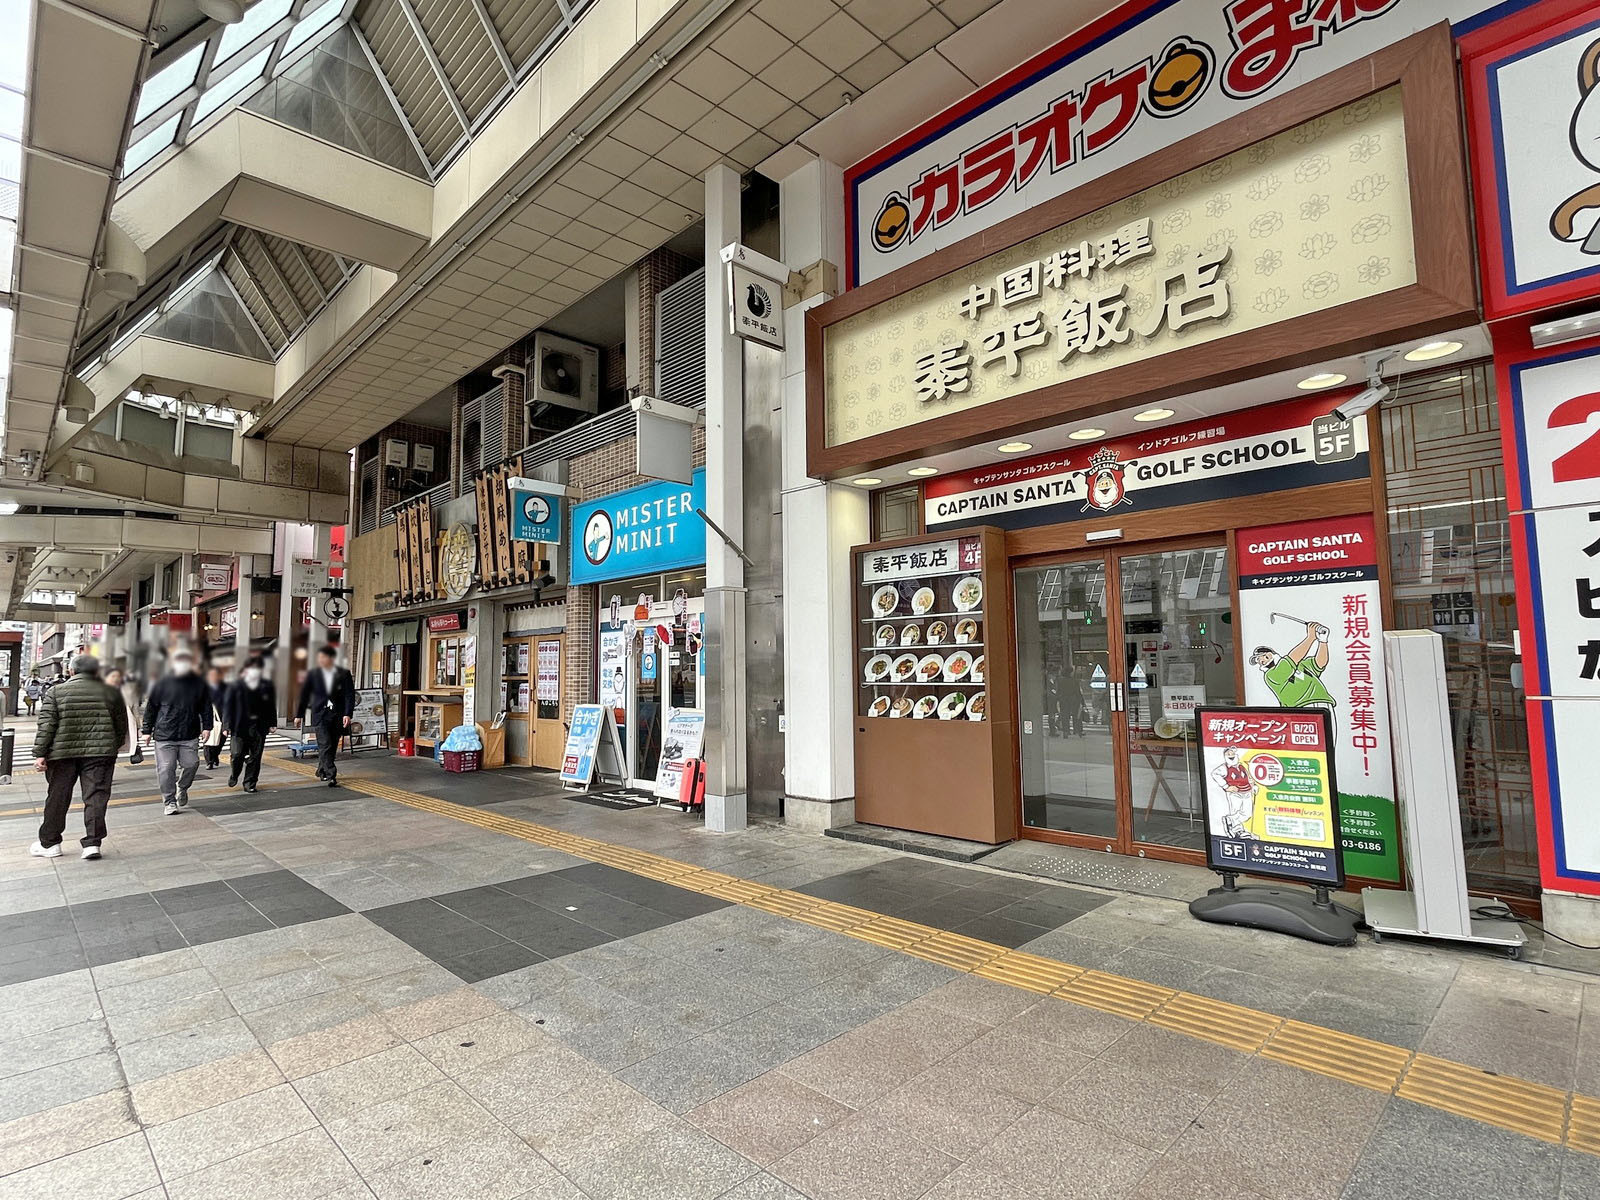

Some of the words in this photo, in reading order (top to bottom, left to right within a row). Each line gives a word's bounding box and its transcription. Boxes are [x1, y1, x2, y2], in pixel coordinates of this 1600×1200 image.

[906, 63, 1150, 238] カラオケ
[959, 217, 1155, 320] 中国料理
[912, 246, 1233, 402] 泰平飯店
[1317, 421, 1350, 435] 当ビル
[1137, 426, 1226, 451] インドアゴルフ練習場
[1319, 434, 1350, 456] 5F
[1137, 457, 1196, 481] GOLF
[1202, 438, 1306, 470] SCHOOL
[937, 491, 1008, 517] CAPTAIN
[1013, 479, 1077, 504] SANTA
[616, 491, 693, 530] MISTER
[521, 525, 551, 535] MISTER
[521, 531, 547, 540] MINIT
[616, 522, 678, 555] MINIT
[1248, 537, 1309, 554] CAPTAIN
[1312, 532, 1364, 546] SANTA
[873, 548, 948, 573] 泰平飯店
[1262, 552, 1295, 566] GOLF
[1296, 549, 1349, 563] SCHOOL
[1207, 719, 1288, 733] 新規オープン
[1294, 723, 1315, 735] 8/20
[1294, 735, 1316, 744] OPEN
[1223, 844, 1244, 857] 5F
[1263, 845, 1298, 856] CAPTAIN
[1298, 849, 1327, 859] SANTA
[1342, 839, 1382, 851] 03-6186
[1264, 852, 1281, 860] GOLF
[1281, 854, 1309, 863] SCHOOL
